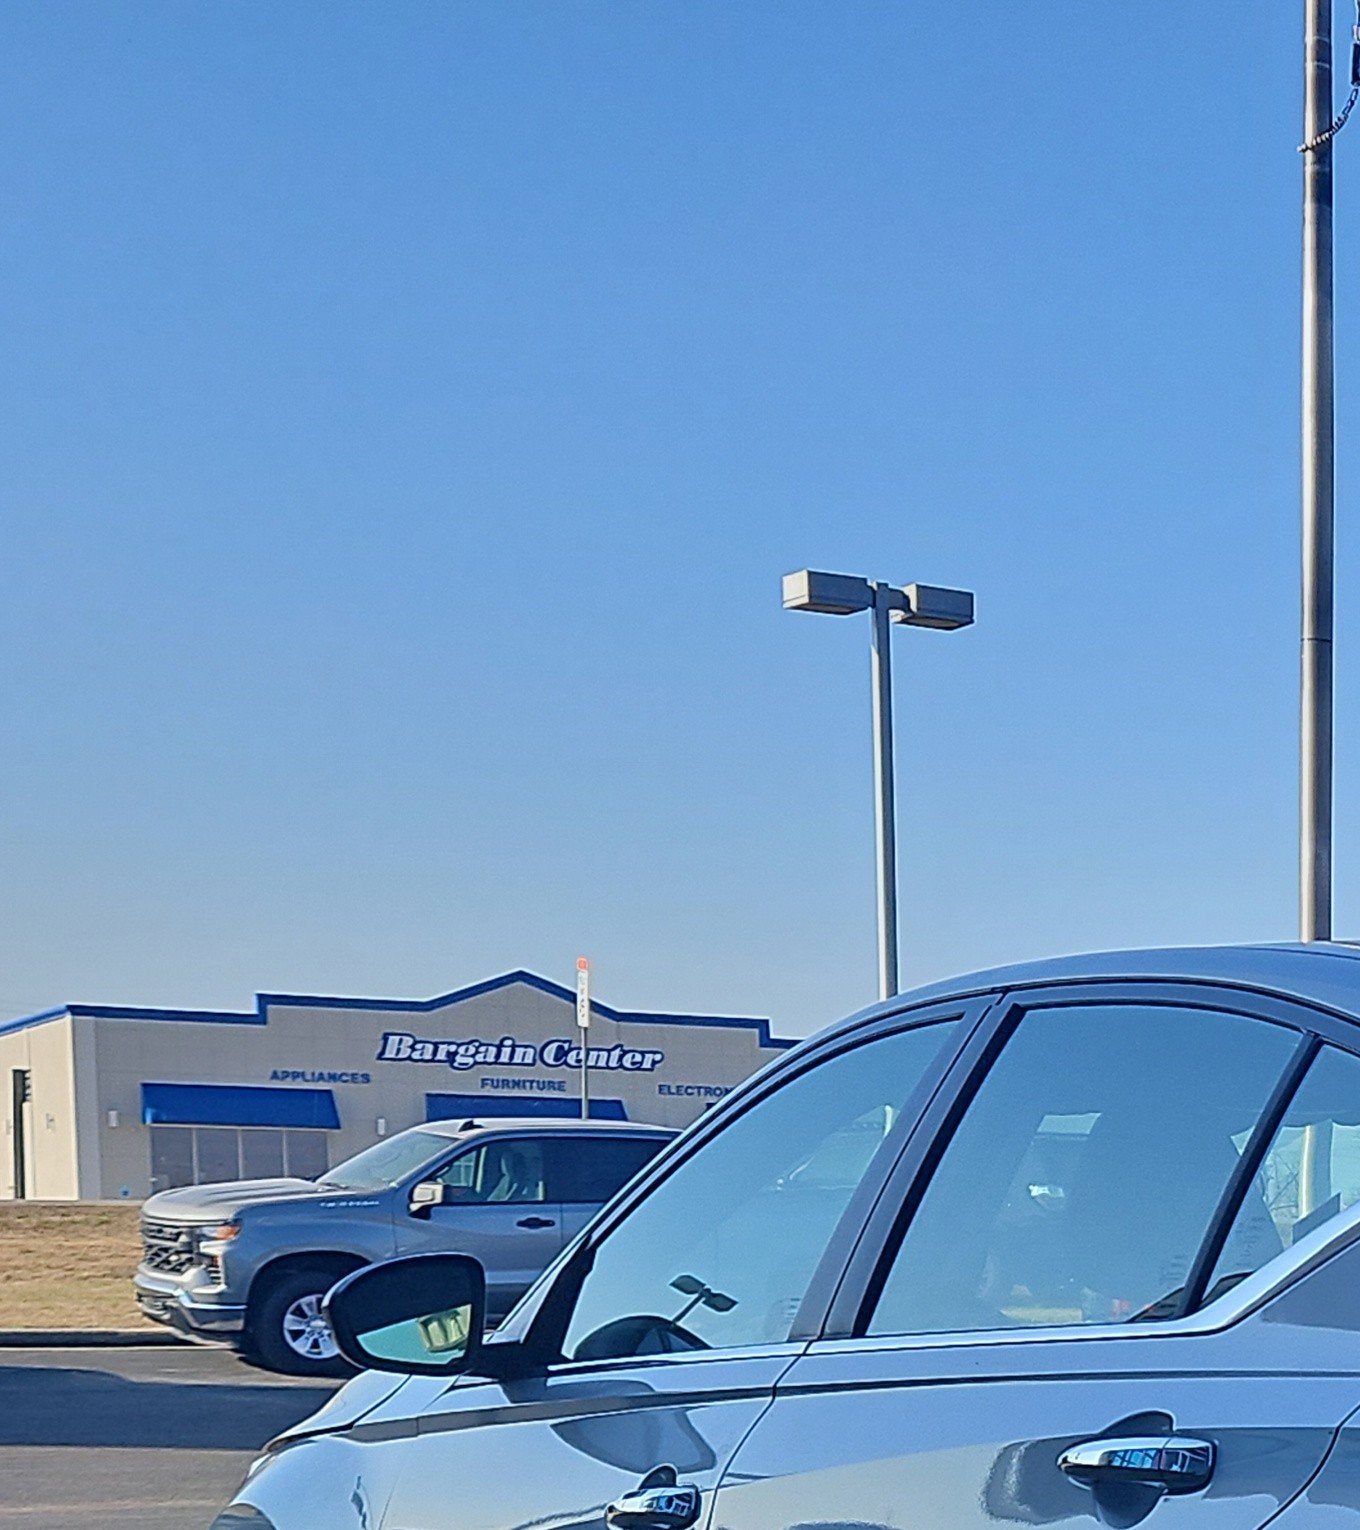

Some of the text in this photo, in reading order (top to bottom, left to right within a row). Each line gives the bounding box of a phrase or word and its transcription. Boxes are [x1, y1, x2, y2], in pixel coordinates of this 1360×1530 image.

[376, 1032, 664, 1071] Bargain Center
[269, 1069, 372, 1084] APPLIANCES
[480, 1077, 568, 1092] FURNITURE
